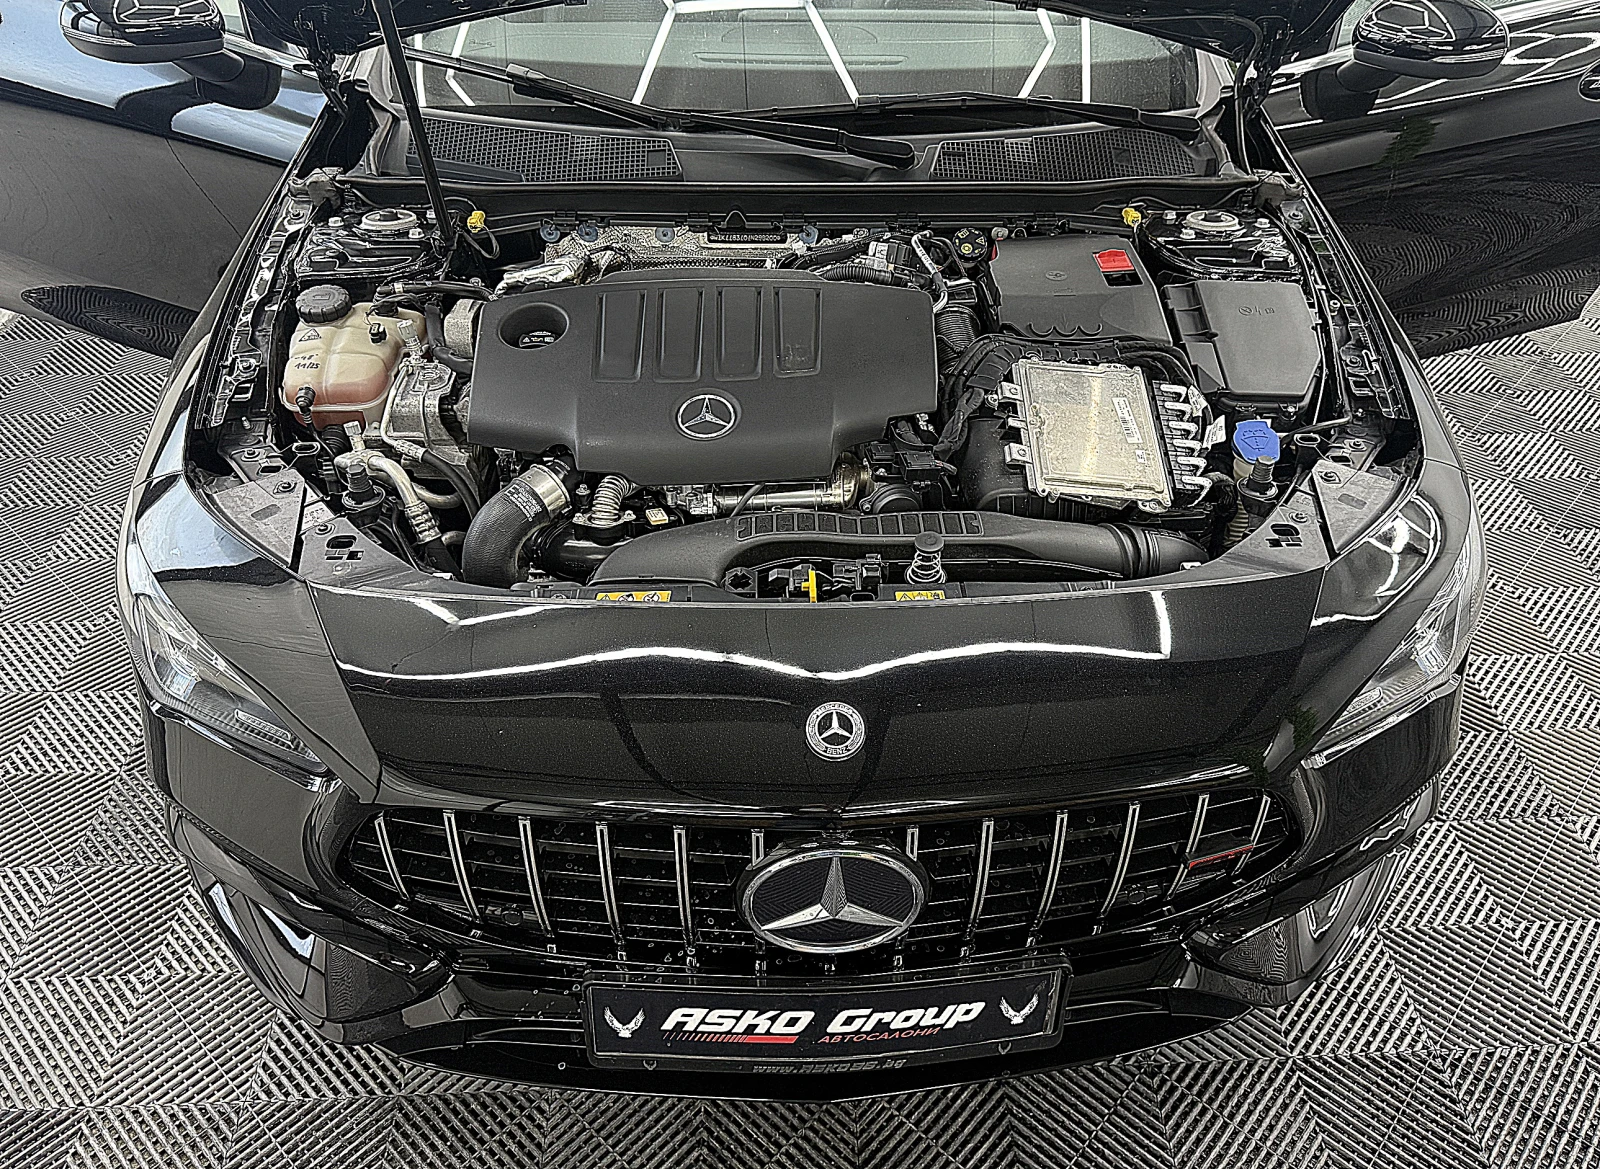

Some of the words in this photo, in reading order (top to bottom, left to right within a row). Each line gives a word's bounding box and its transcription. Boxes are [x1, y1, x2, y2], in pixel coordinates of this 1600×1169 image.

[826, 747, 848, 755] BENZ
[660, 1007, 816, 1034] ASKO
[826, 1001, 986, 1034] Group
[817, 1026, 941, 1044] АВТОСАЛОНИ
